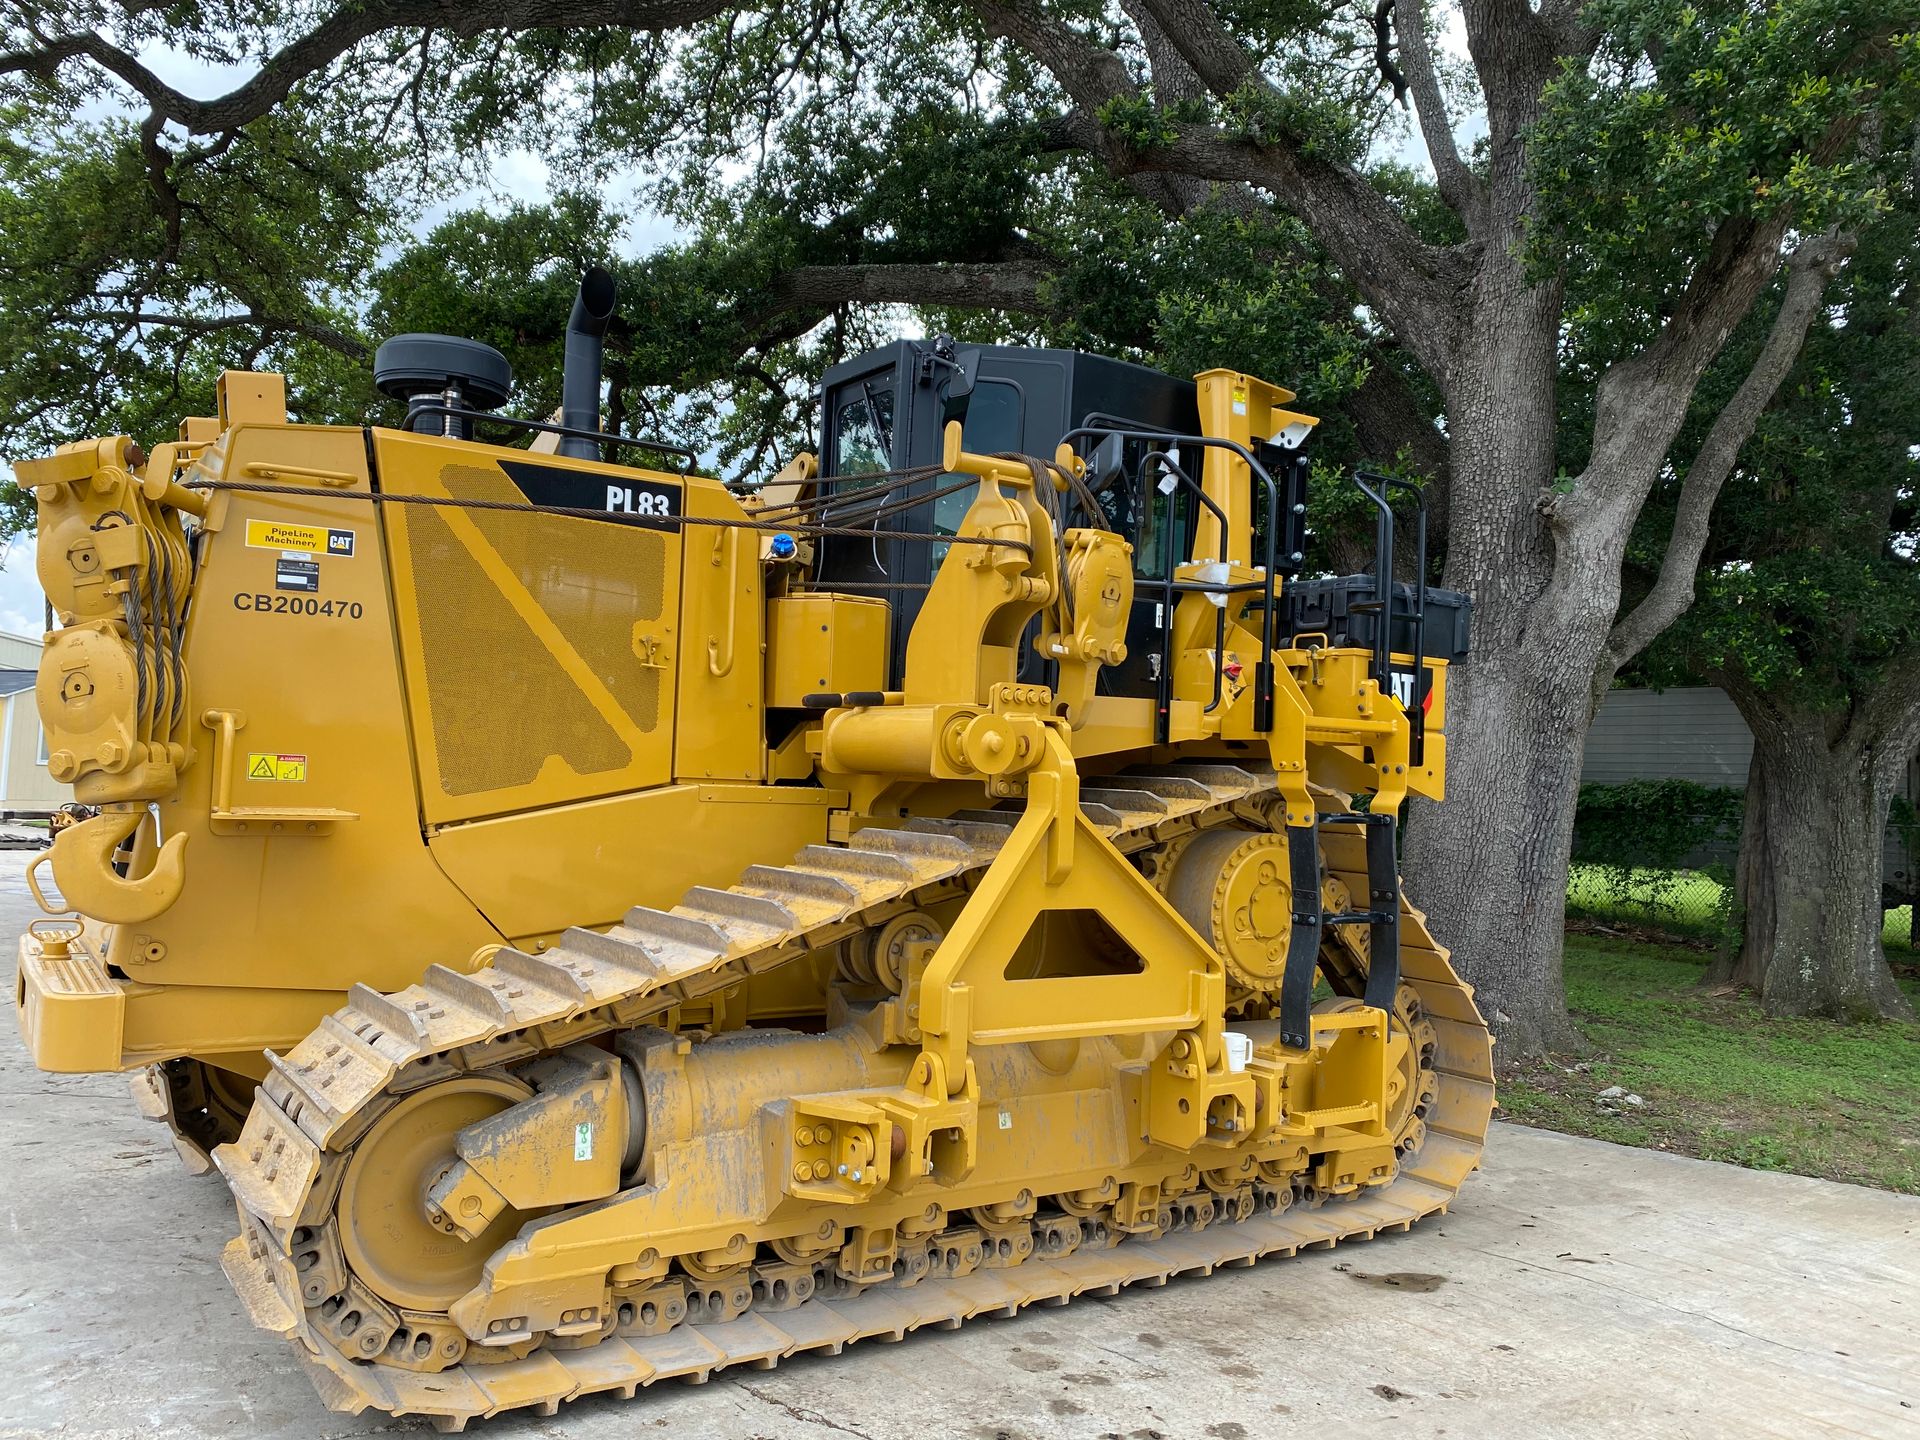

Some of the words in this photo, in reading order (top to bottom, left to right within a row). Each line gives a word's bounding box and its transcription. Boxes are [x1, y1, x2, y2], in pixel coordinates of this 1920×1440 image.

[606, 485, 669, 522] PL83
[265, 535, 317, 548] Machinery
[271, 527, 314, 539] PipeLine
[329, 535, 352, 550] CAT
[233, 592, 363, 620] CB200470
[1389, 671, 1416, 711] AT
